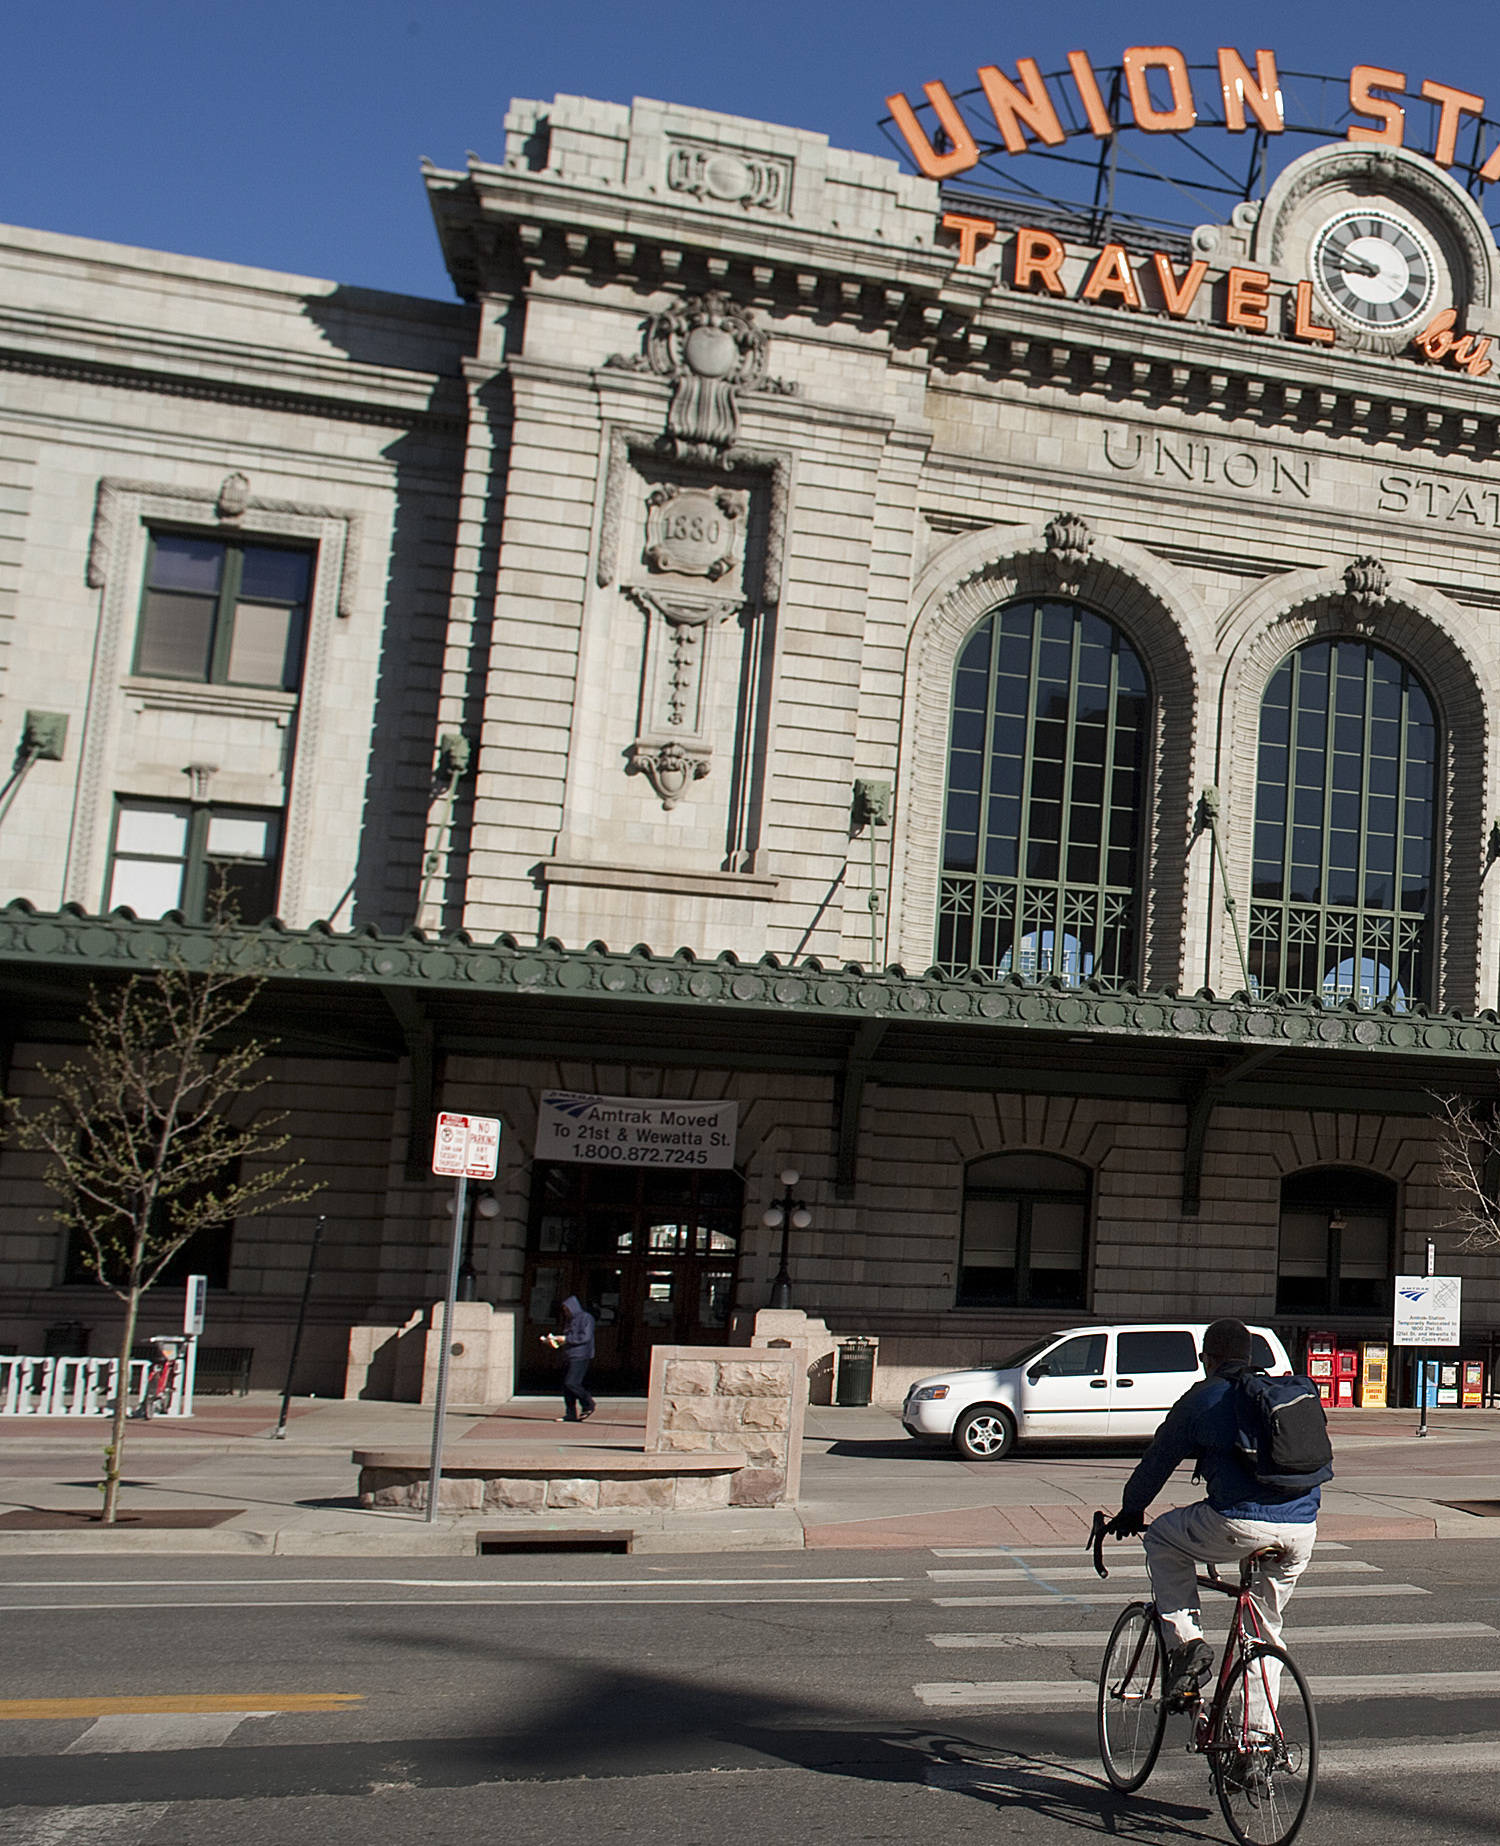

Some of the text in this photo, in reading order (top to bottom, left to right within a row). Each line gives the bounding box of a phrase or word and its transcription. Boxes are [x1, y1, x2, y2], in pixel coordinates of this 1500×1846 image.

[886, 46, 1284, 180] UNION
[942, 213, 1335, 345] TRAVEL
[1414, 308, 1493, 377] by
[1102, 428, 1311, 498] UNION
[664, 515, 720, 544] 1880
[588, 1107, 719, 1128] Amtrak Moved
[553, 1123, 731, 1147] To 21st & Wewatta St.
[573, 1143, 708, 1165] 1.800.872.7245
